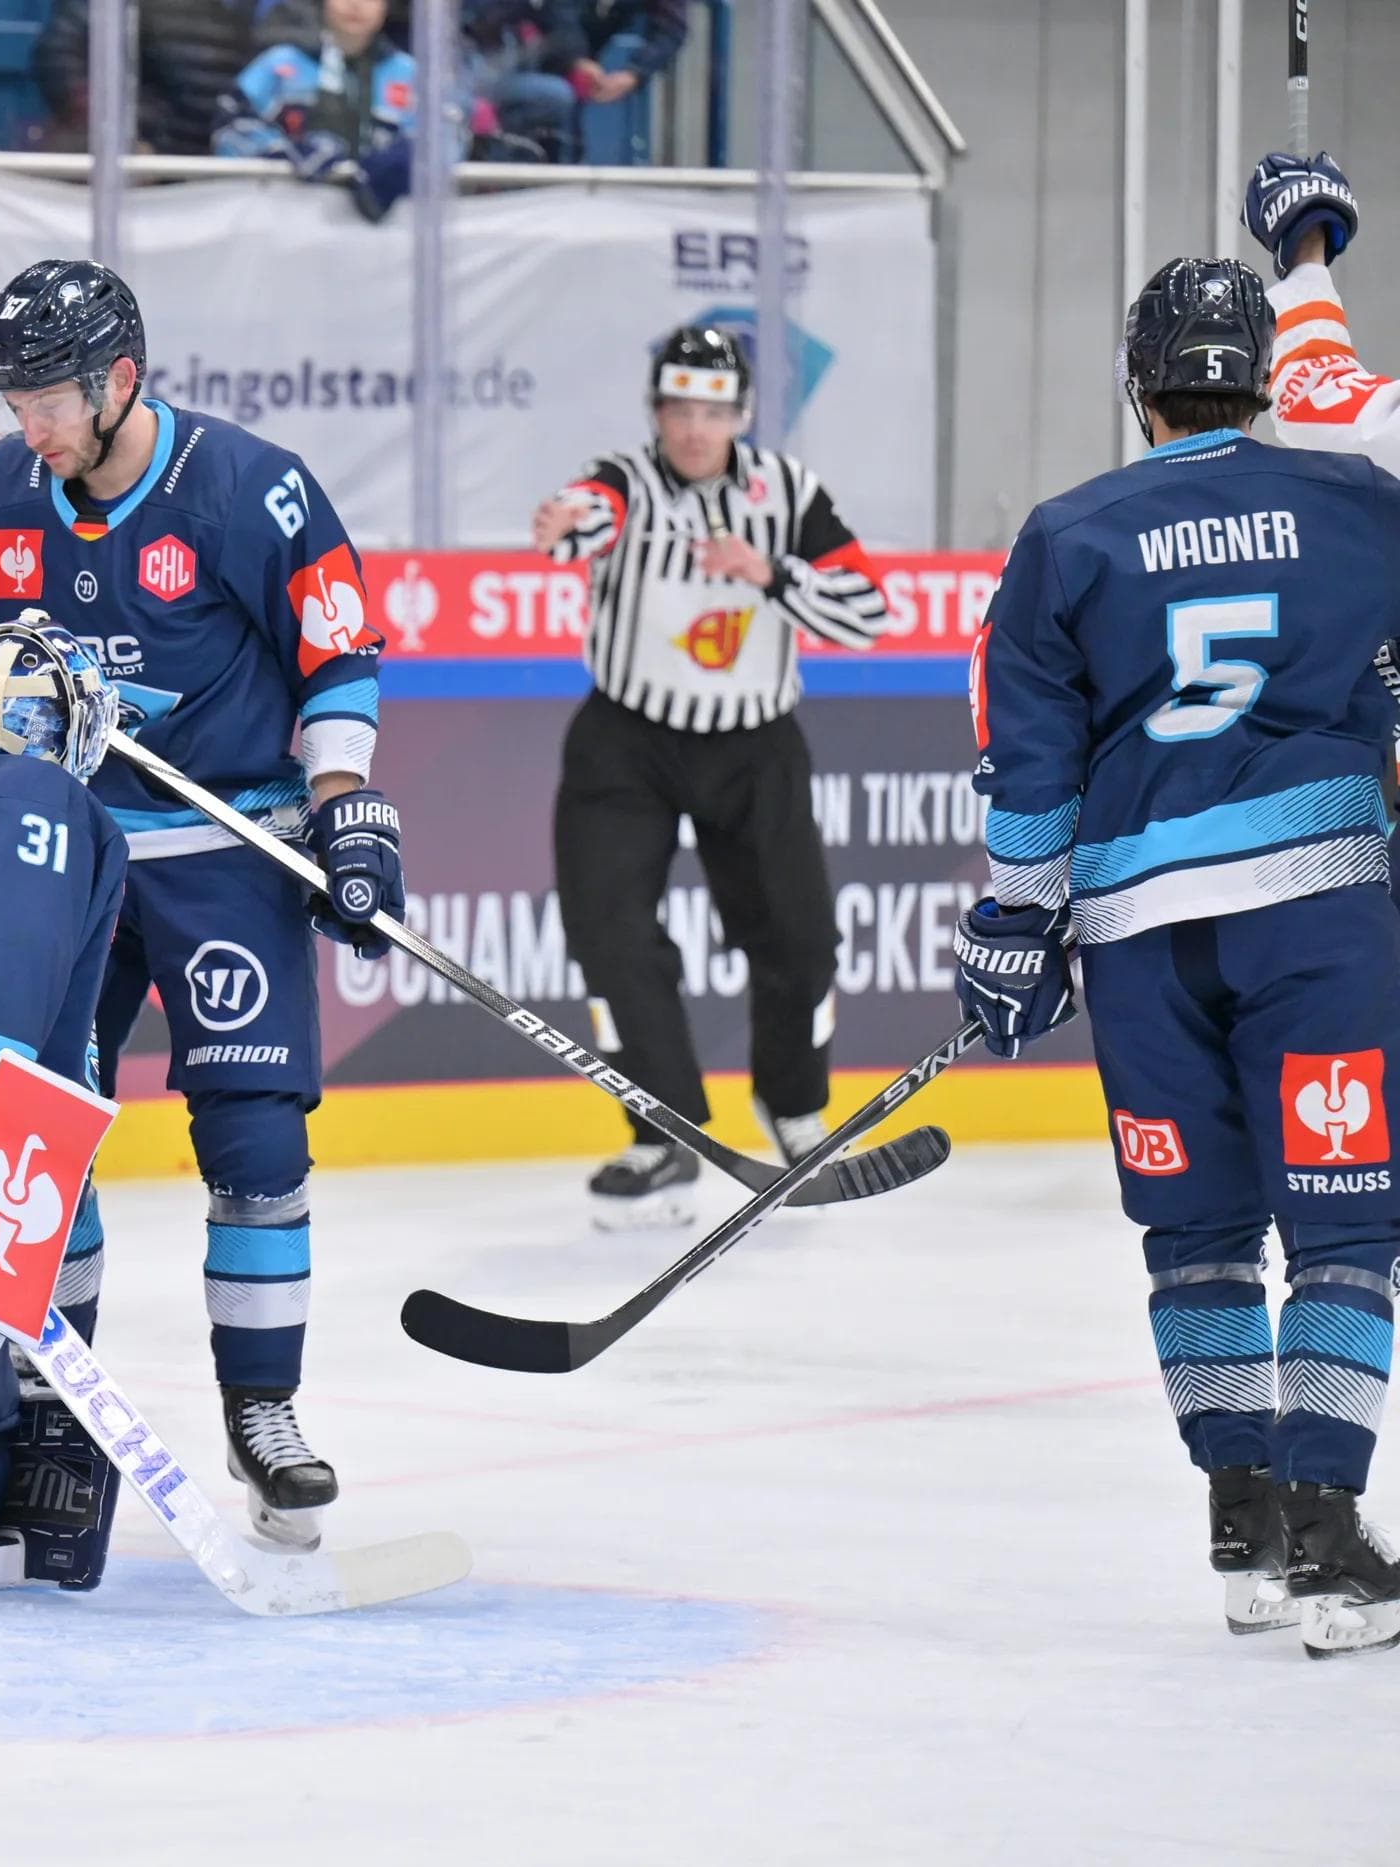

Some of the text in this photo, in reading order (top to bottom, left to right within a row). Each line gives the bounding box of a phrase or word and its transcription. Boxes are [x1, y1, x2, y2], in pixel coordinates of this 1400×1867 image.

[1206, 349, 1223, 380] 5
[163, 425, 206, 496] WARRIOR
[263, 467, 311, 539] 67
[145, 544, 191, 593] CHL
[1137, 510, 1300, 573] WAGNER
[75, 634, 143, 665] RC
[1141, 592, 1280, 744] 5
[863, 773, 990, 847] TIKTO
[16, 812, 69, 875] 31
[185, 1045, 290, 1067] WARRIOR
[505, 1008, 661, 1116] BAUER
[1121, 1120, 1175, 1167] DB
[1287, 1169, 1392, 1195] STRAUSS
